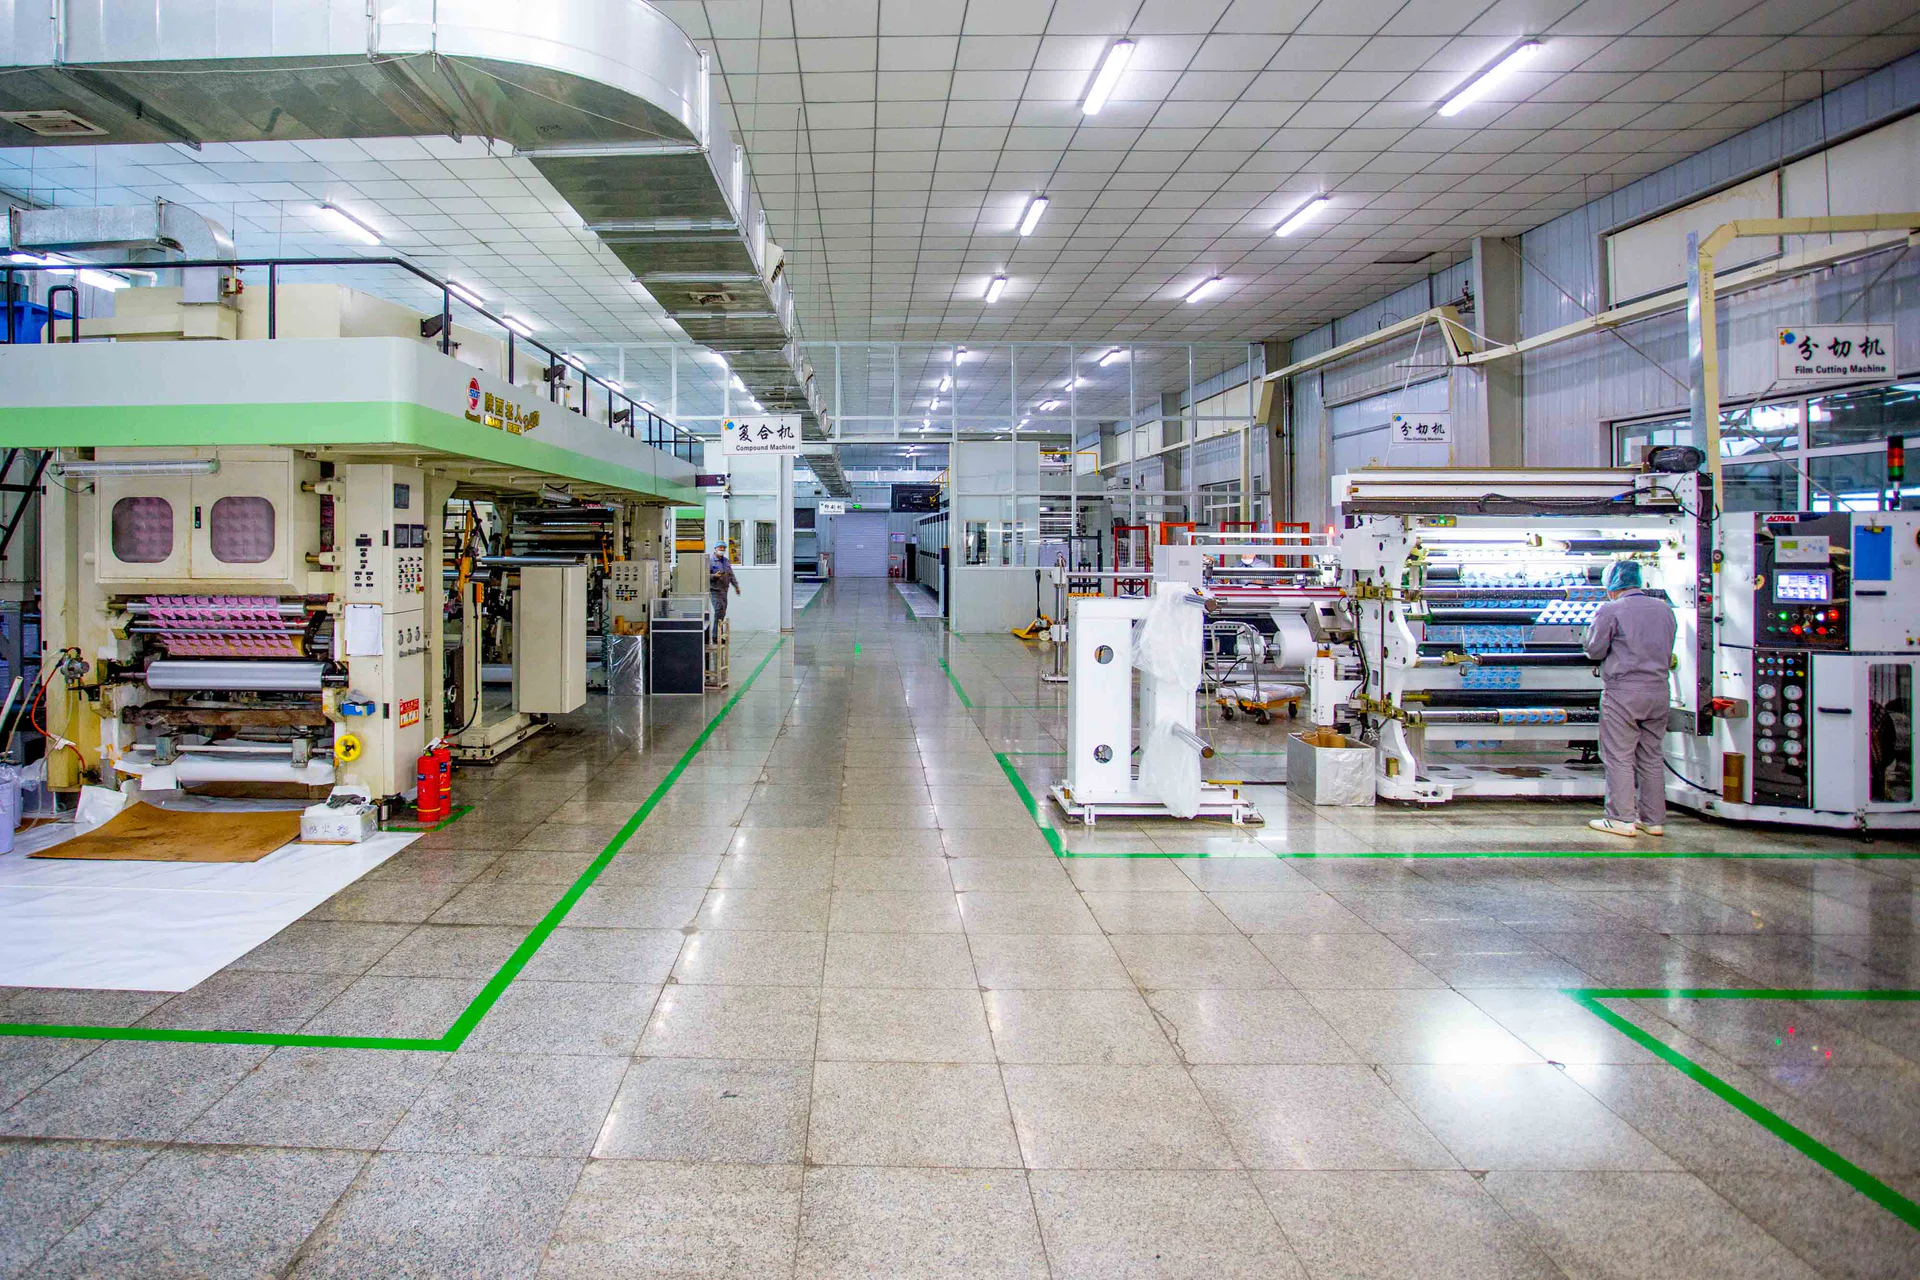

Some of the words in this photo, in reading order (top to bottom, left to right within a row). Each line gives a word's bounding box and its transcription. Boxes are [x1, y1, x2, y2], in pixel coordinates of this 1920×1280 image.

[1798, 335, 1885, 361] 分切机
[1795, 365, 1813, 374] Film
[1816, 365, 1847, 374] Cutting
[1849, 364, 1886, 374] Machine
[738, 423, 794, 442] 复合机
[1401, 421, 1446, 436] 分切机
[769, 443, 795, 451] Machine
